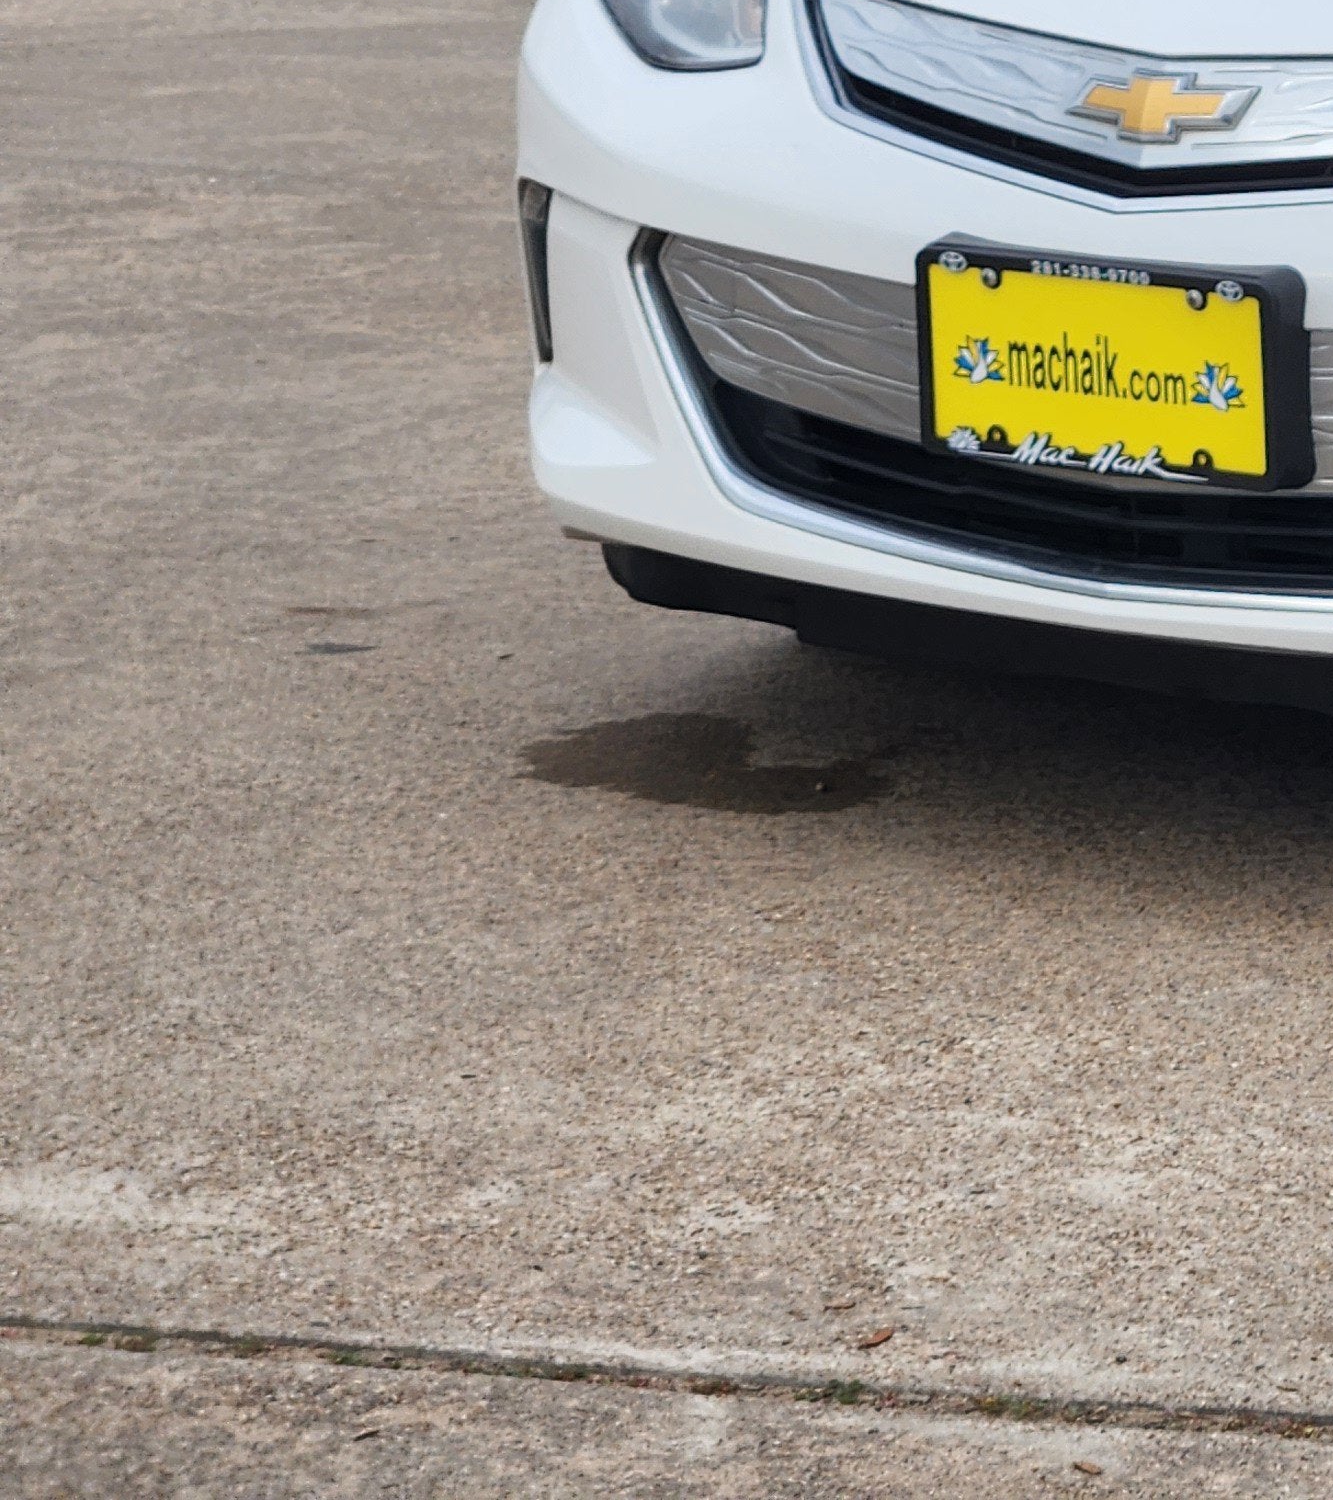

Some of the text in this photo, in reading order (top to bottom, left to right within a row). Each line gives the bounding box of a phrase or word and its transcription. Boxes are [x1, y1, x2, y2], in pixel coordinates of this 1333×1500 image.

[1007, 331, 1187, 405] machaik.com
[1011, 431, 1172, 478] Mac Haik
